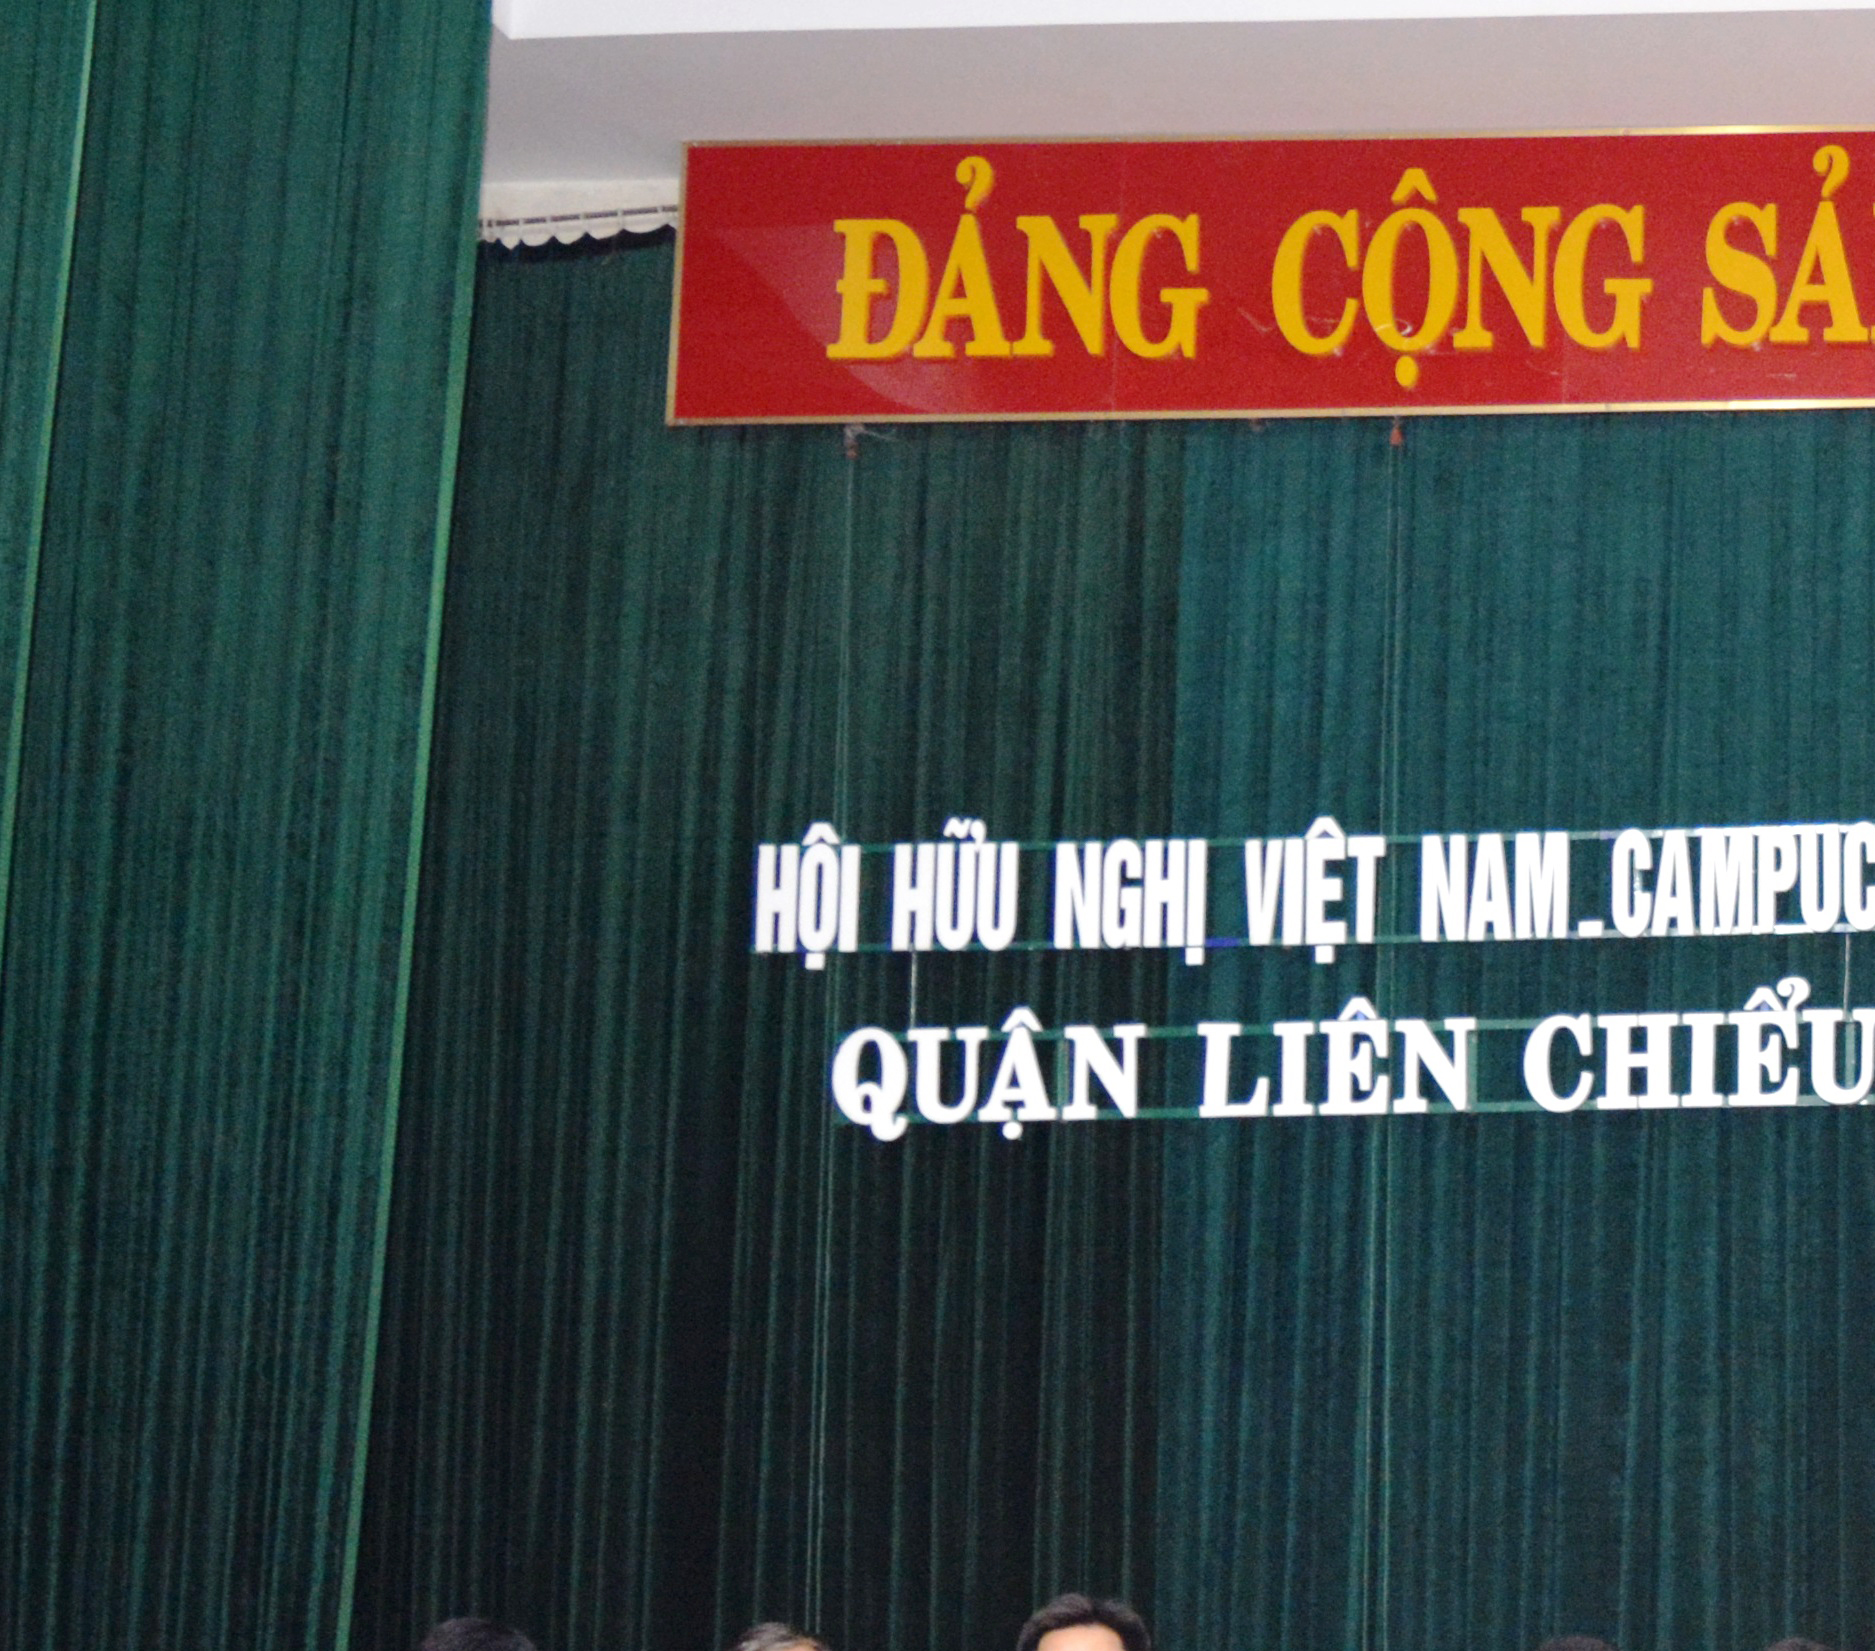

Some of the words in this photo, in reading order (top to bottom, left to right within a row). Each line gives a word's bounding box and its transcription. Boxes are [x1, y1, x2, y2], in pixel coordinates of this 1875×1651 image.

[826, 155, 1209, 359] ĐẢNG
[1271, 167, 1653, 389] CỘNG
[755, 823, 860, 970] HỘI
[891, 817, 1018, 952] HỮU
[1054, 839, 1207, 965] NGHỊ
[1244, 816, 1386, 963] VIỆT
[832, 1007, 1147, 1141] QUẬN
[1197, 998, 1477, 1118] LIÊN
